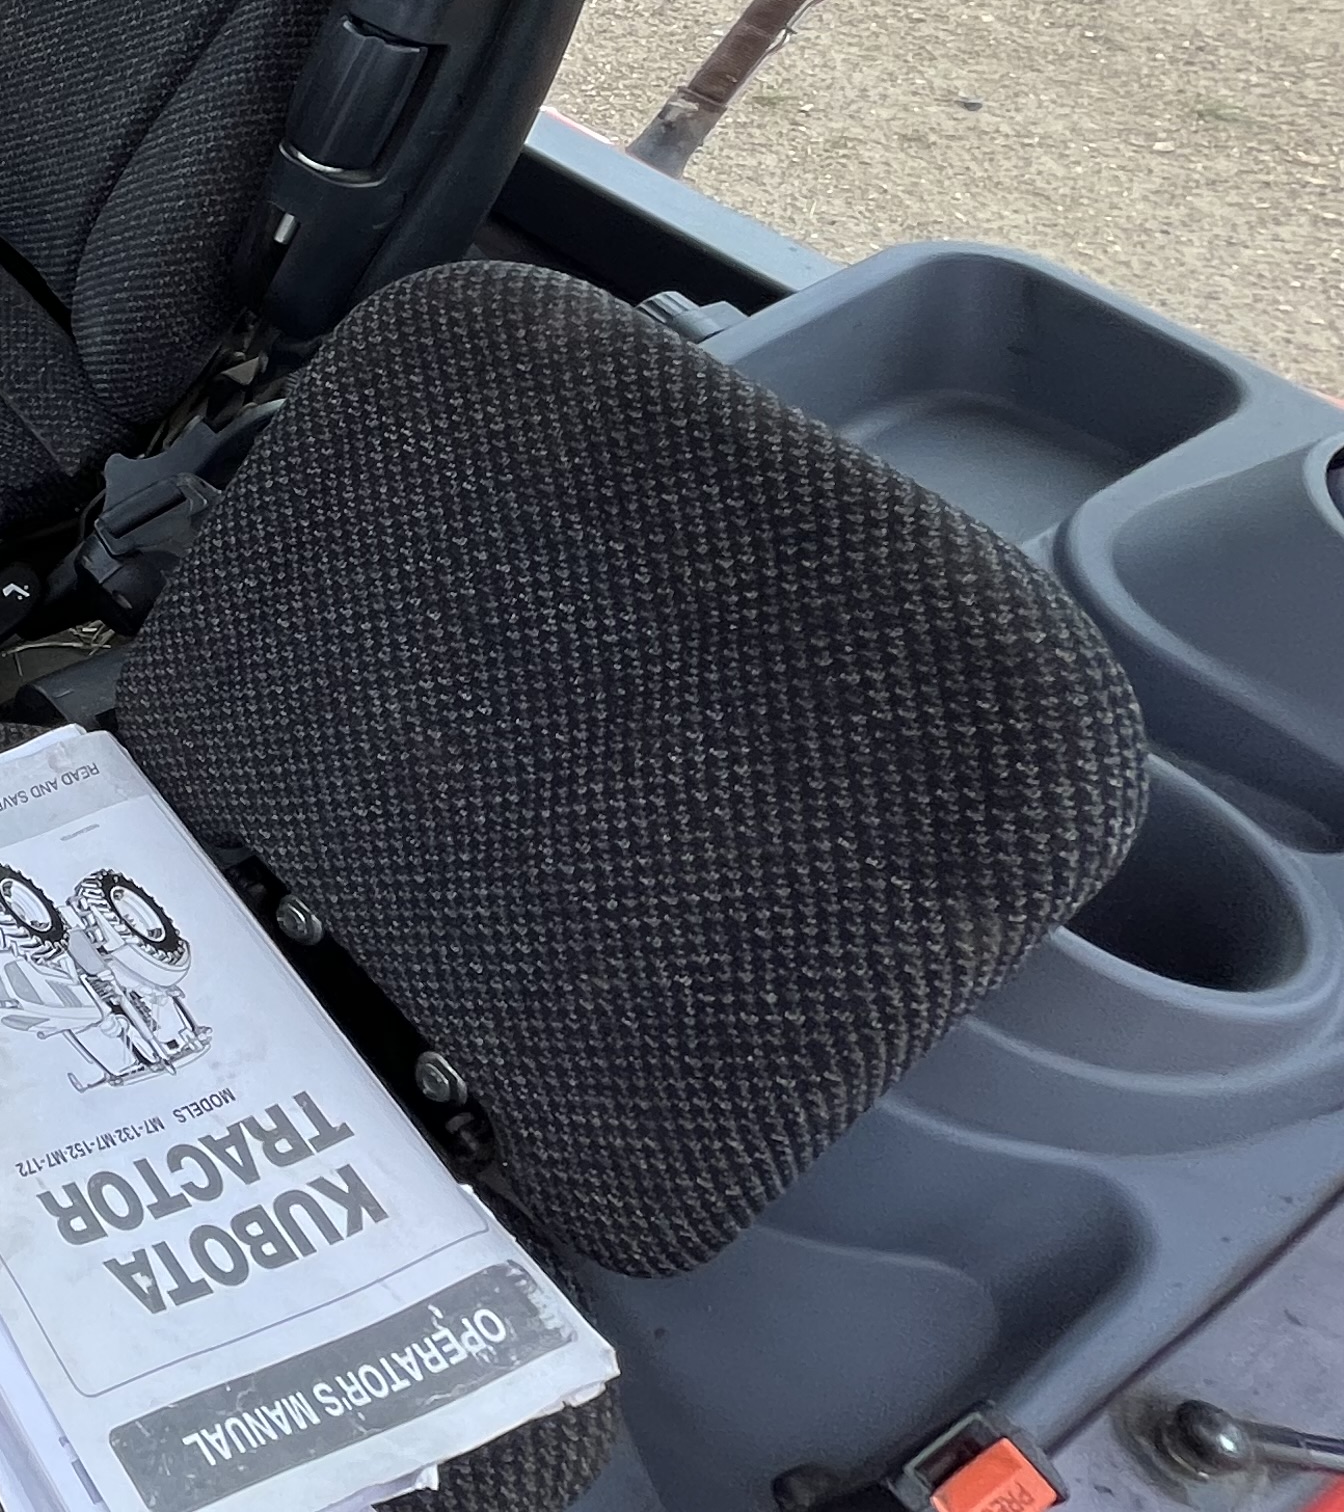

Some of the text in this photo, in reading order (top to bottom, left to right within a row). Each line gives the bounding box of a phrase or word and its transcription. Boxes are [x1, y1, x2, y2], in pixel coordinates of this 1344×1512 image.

[30, 780, 59, 799] AND
[61, 762, 101, 786] READ
[172, 1087, 237, 1124] MODELS
[36, 1090, 356, 1246] TRACTOR
[102, 1164, 389, 1315] KUBOTA
[181, 1308, 507, 1466] OPERATOR'S MANUAL
